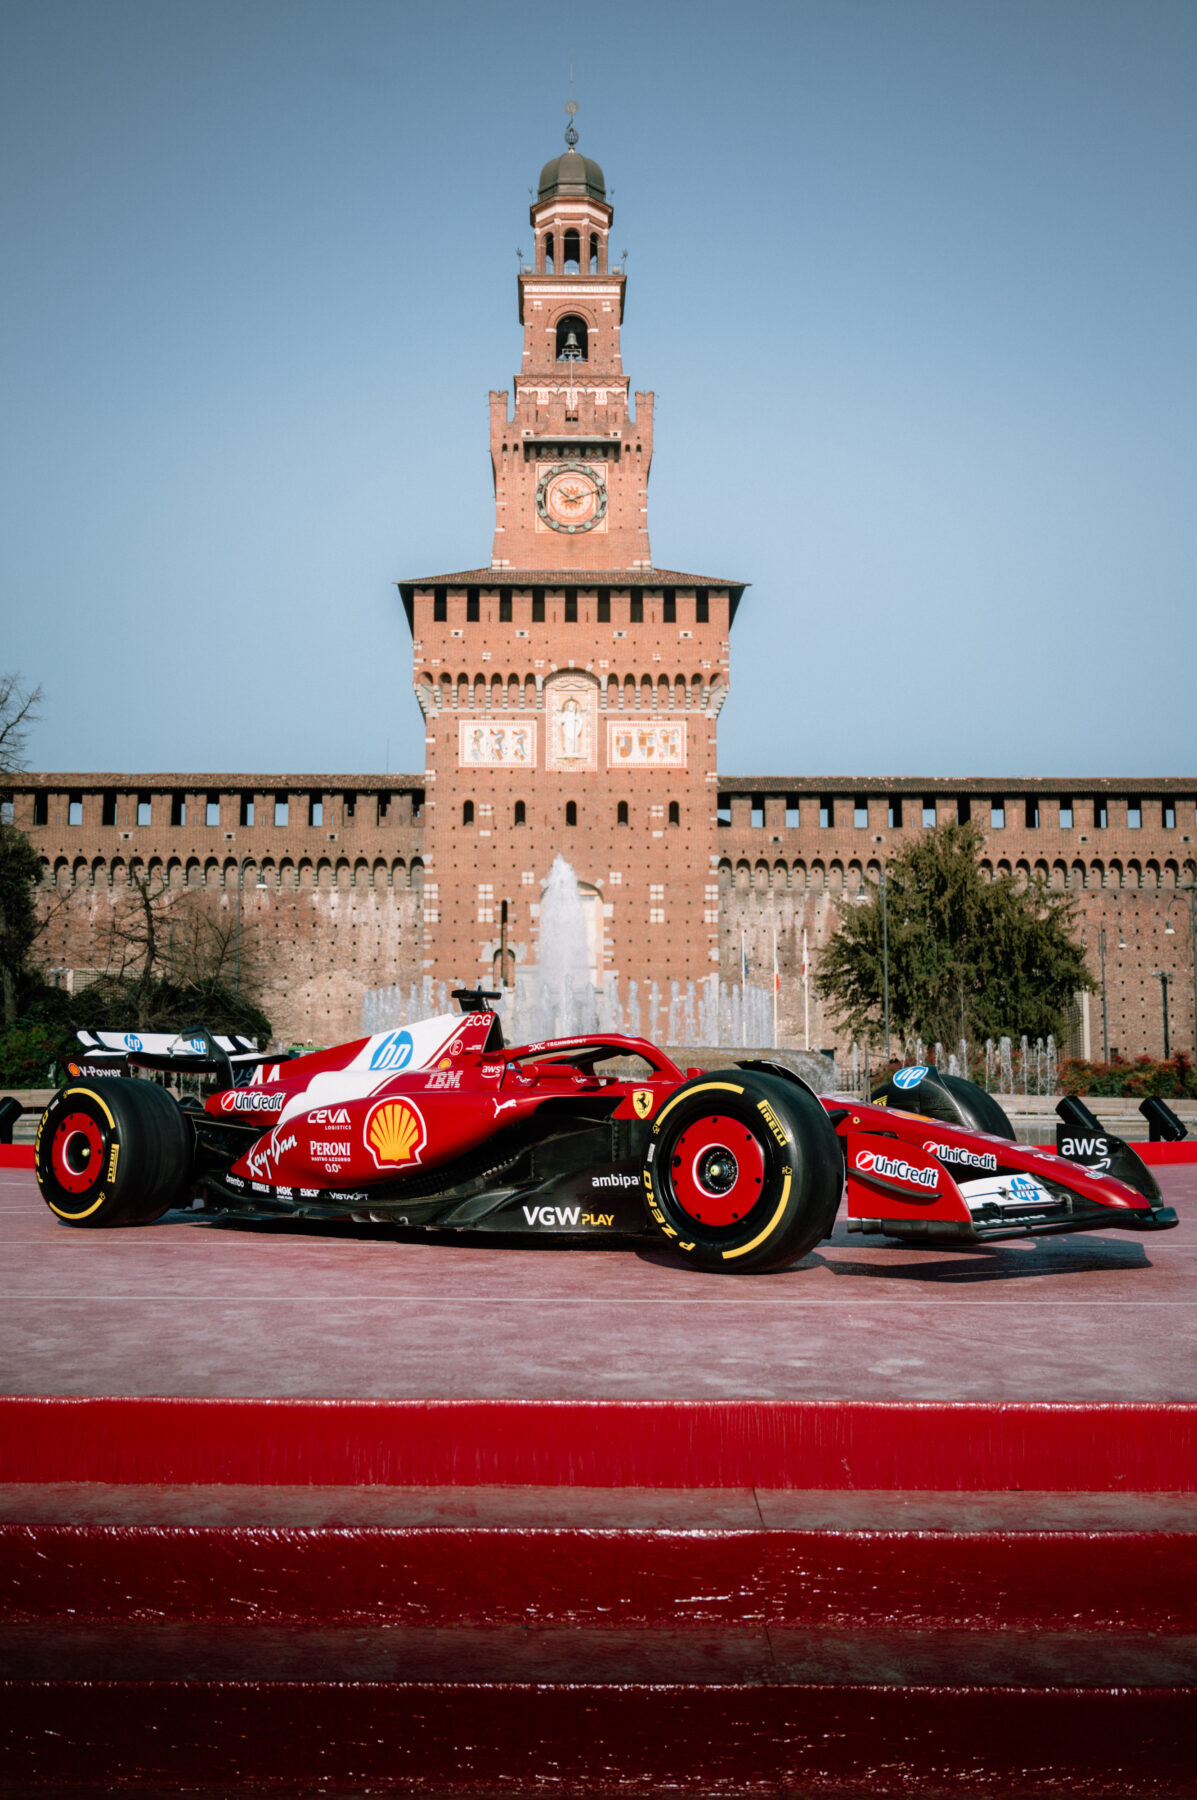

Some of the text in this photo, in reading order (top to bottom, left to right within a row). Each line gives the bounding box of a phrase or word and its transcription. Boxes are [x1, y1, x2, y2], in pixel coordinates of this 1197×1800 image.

[466, 1014, 491, 1026] ZCG
[125, 1034, 142, 1051] hp
[368, 1030, 413, 1071] hp
[547, 1038, 587, 1047] TECHNOLOGY
[79, 1066, 122, 1078] V-Power
[482, 1065, 500, 1073] aws
[894, 1066, 928, 1089] hp
[424, 1071, 463, 1088] IBM
[234, 1092, 286, 1111] UniCredit
[757, 1099, 791, 1147] PIRELLI
[309, 1140, 351, 1156] PERONI
[1061, 1138, 1108, 1156] aws
[938, 1145, 997, 1171] UniCredit
[874, 1155, 939, 1188] UniCredit
[276, 1186, 293, 1196] NGK
[1011, 1177, 1040, 1202] hp
[522, 1206, 615, 1226] VGW PLAY
[643, 1170, 696, 1251] P ZERO
